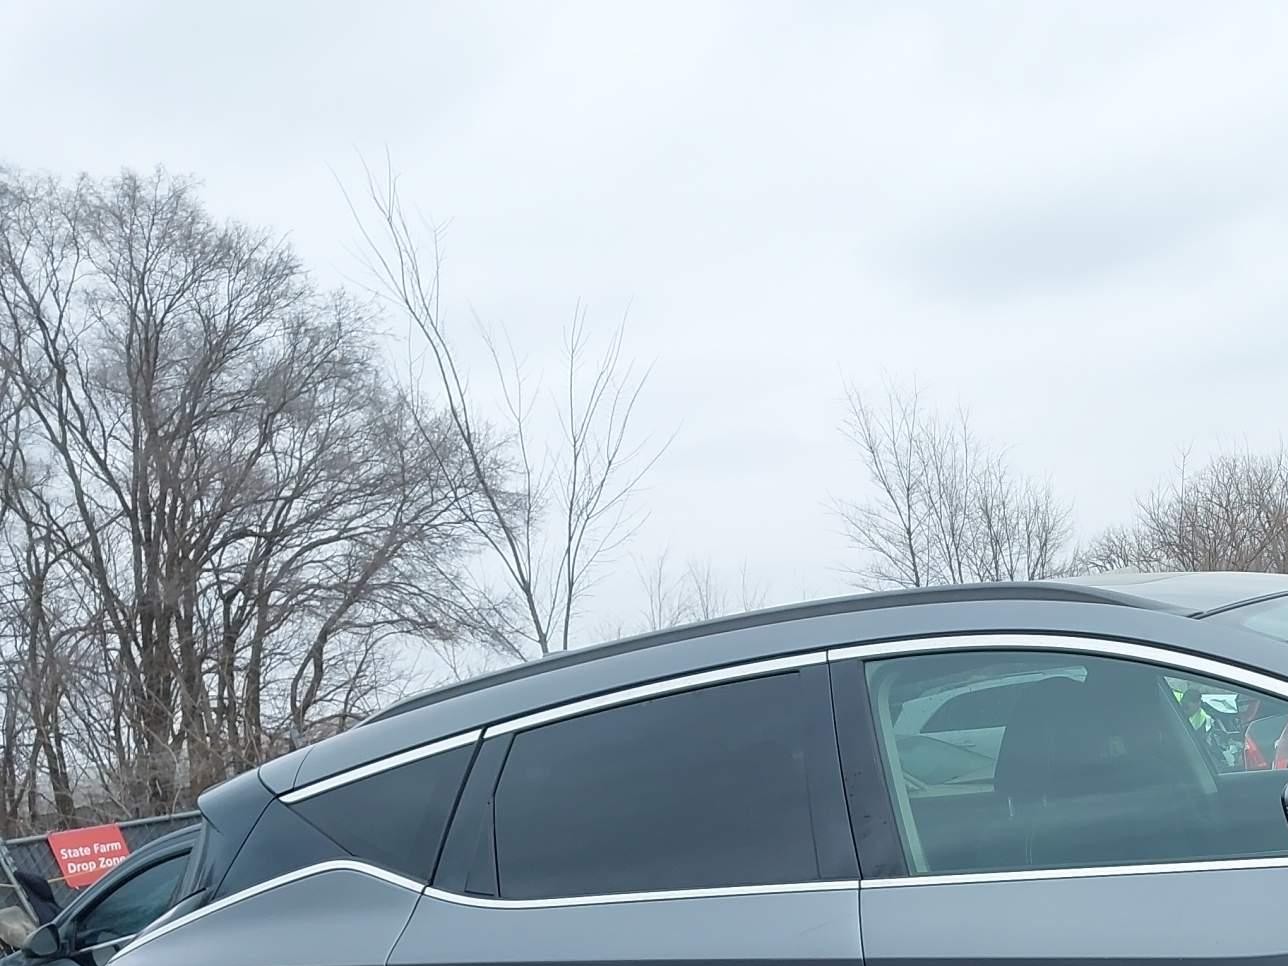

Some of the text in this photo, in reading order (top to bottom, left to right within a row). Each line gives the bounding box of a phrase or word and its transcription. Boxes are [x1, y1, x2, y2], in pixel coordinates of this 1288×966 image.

[60, 841, 121, 860] State Farm
[67, 861, 97, 874] Drop
